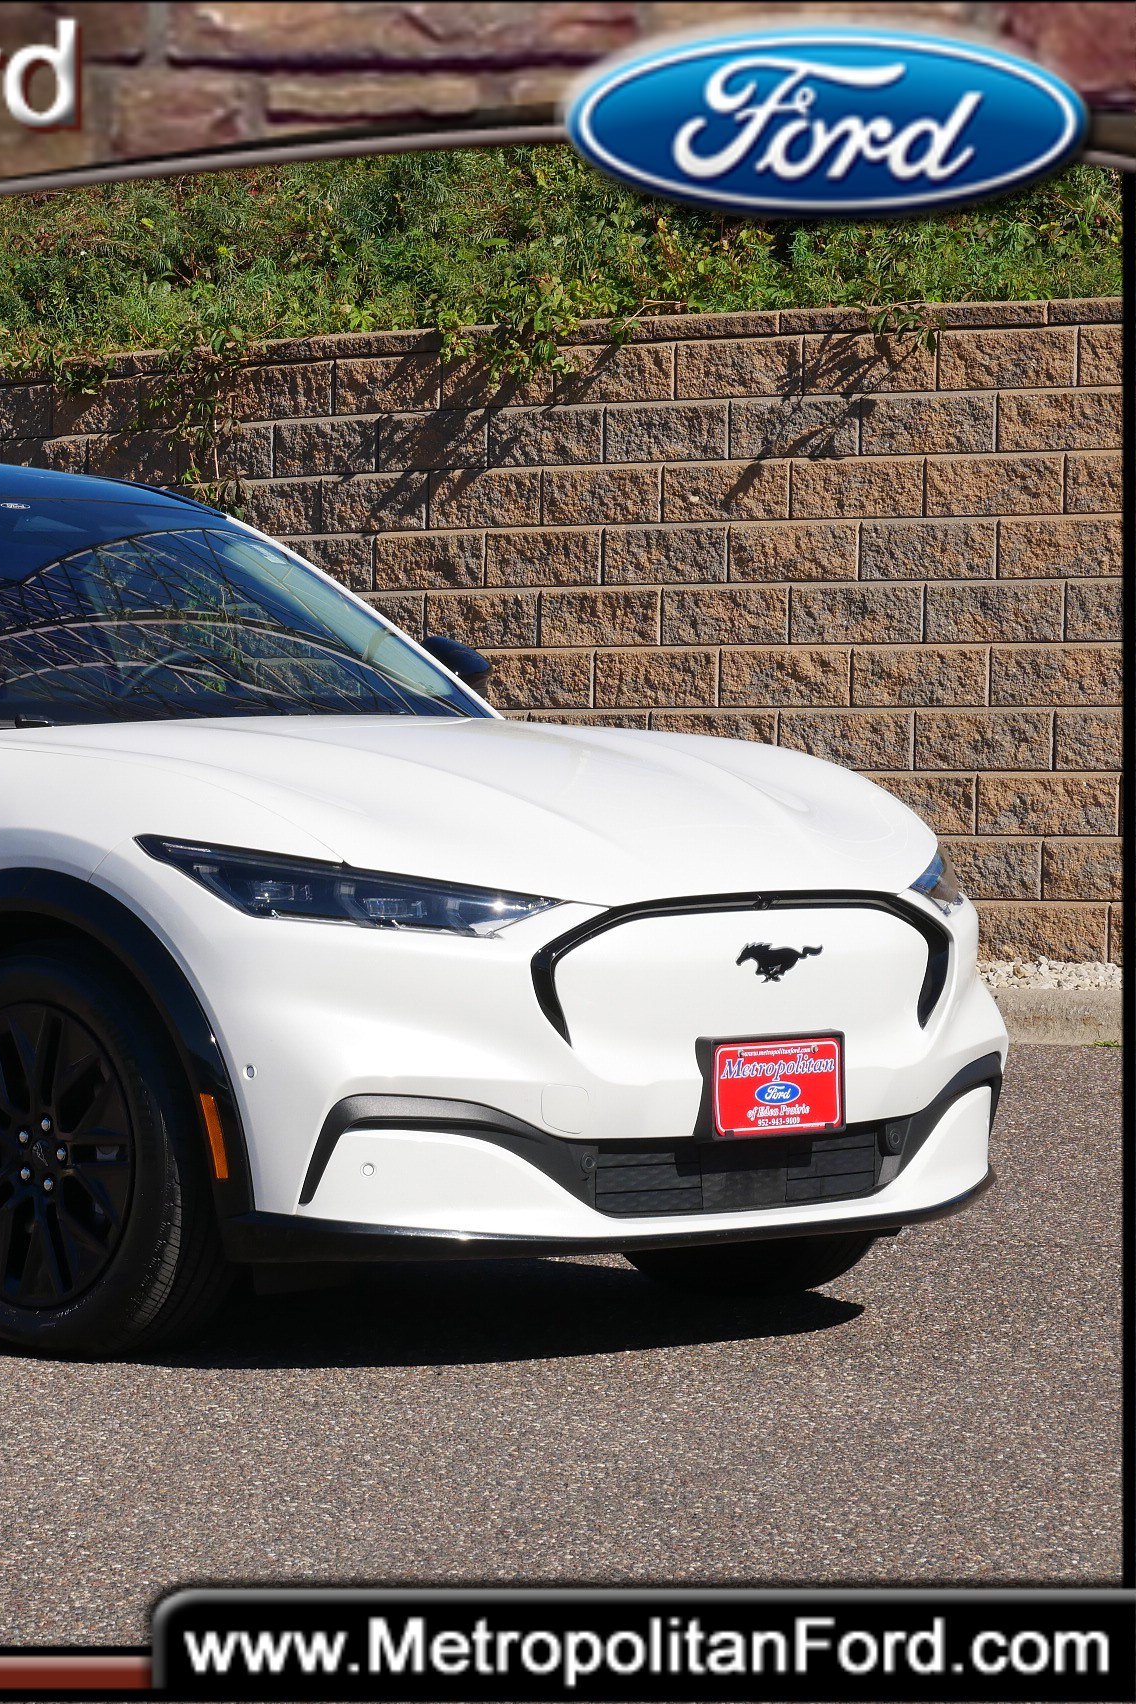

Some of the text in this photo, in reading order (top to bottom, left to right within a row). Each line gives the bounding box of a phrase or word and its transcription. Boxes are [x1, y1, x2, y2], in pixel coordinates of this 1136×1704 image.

[721, 1054, 835, 1081] Metropolitan
[764, 1085, 791, 1101] Ford
[747, 1106, 758, 1121] of
